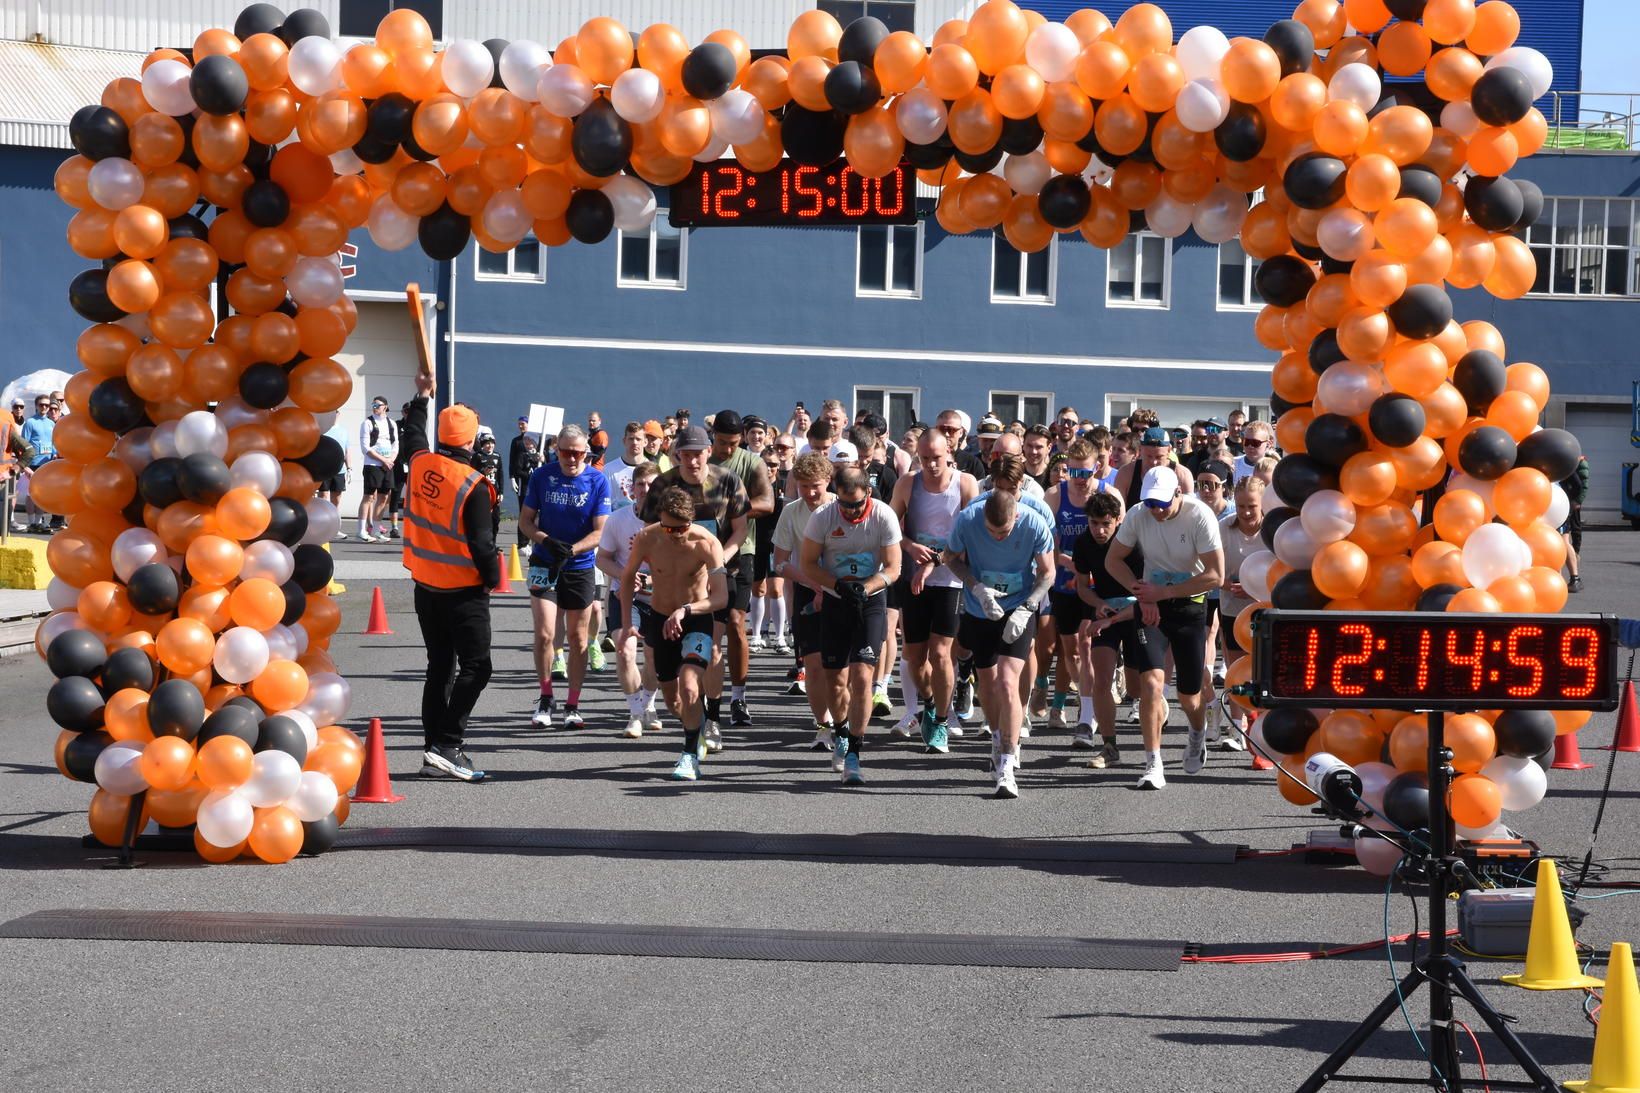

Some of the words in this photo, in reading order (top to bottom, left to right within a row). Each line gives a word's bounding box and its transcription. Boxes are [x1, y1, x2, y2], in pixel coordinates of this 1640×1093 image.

[850, 563, 858, 574] 9
[531, 575, 548, 586] 724
[695, 643, 703, 653] 4
[1305, 624, 1598, 696] 12:14:59
